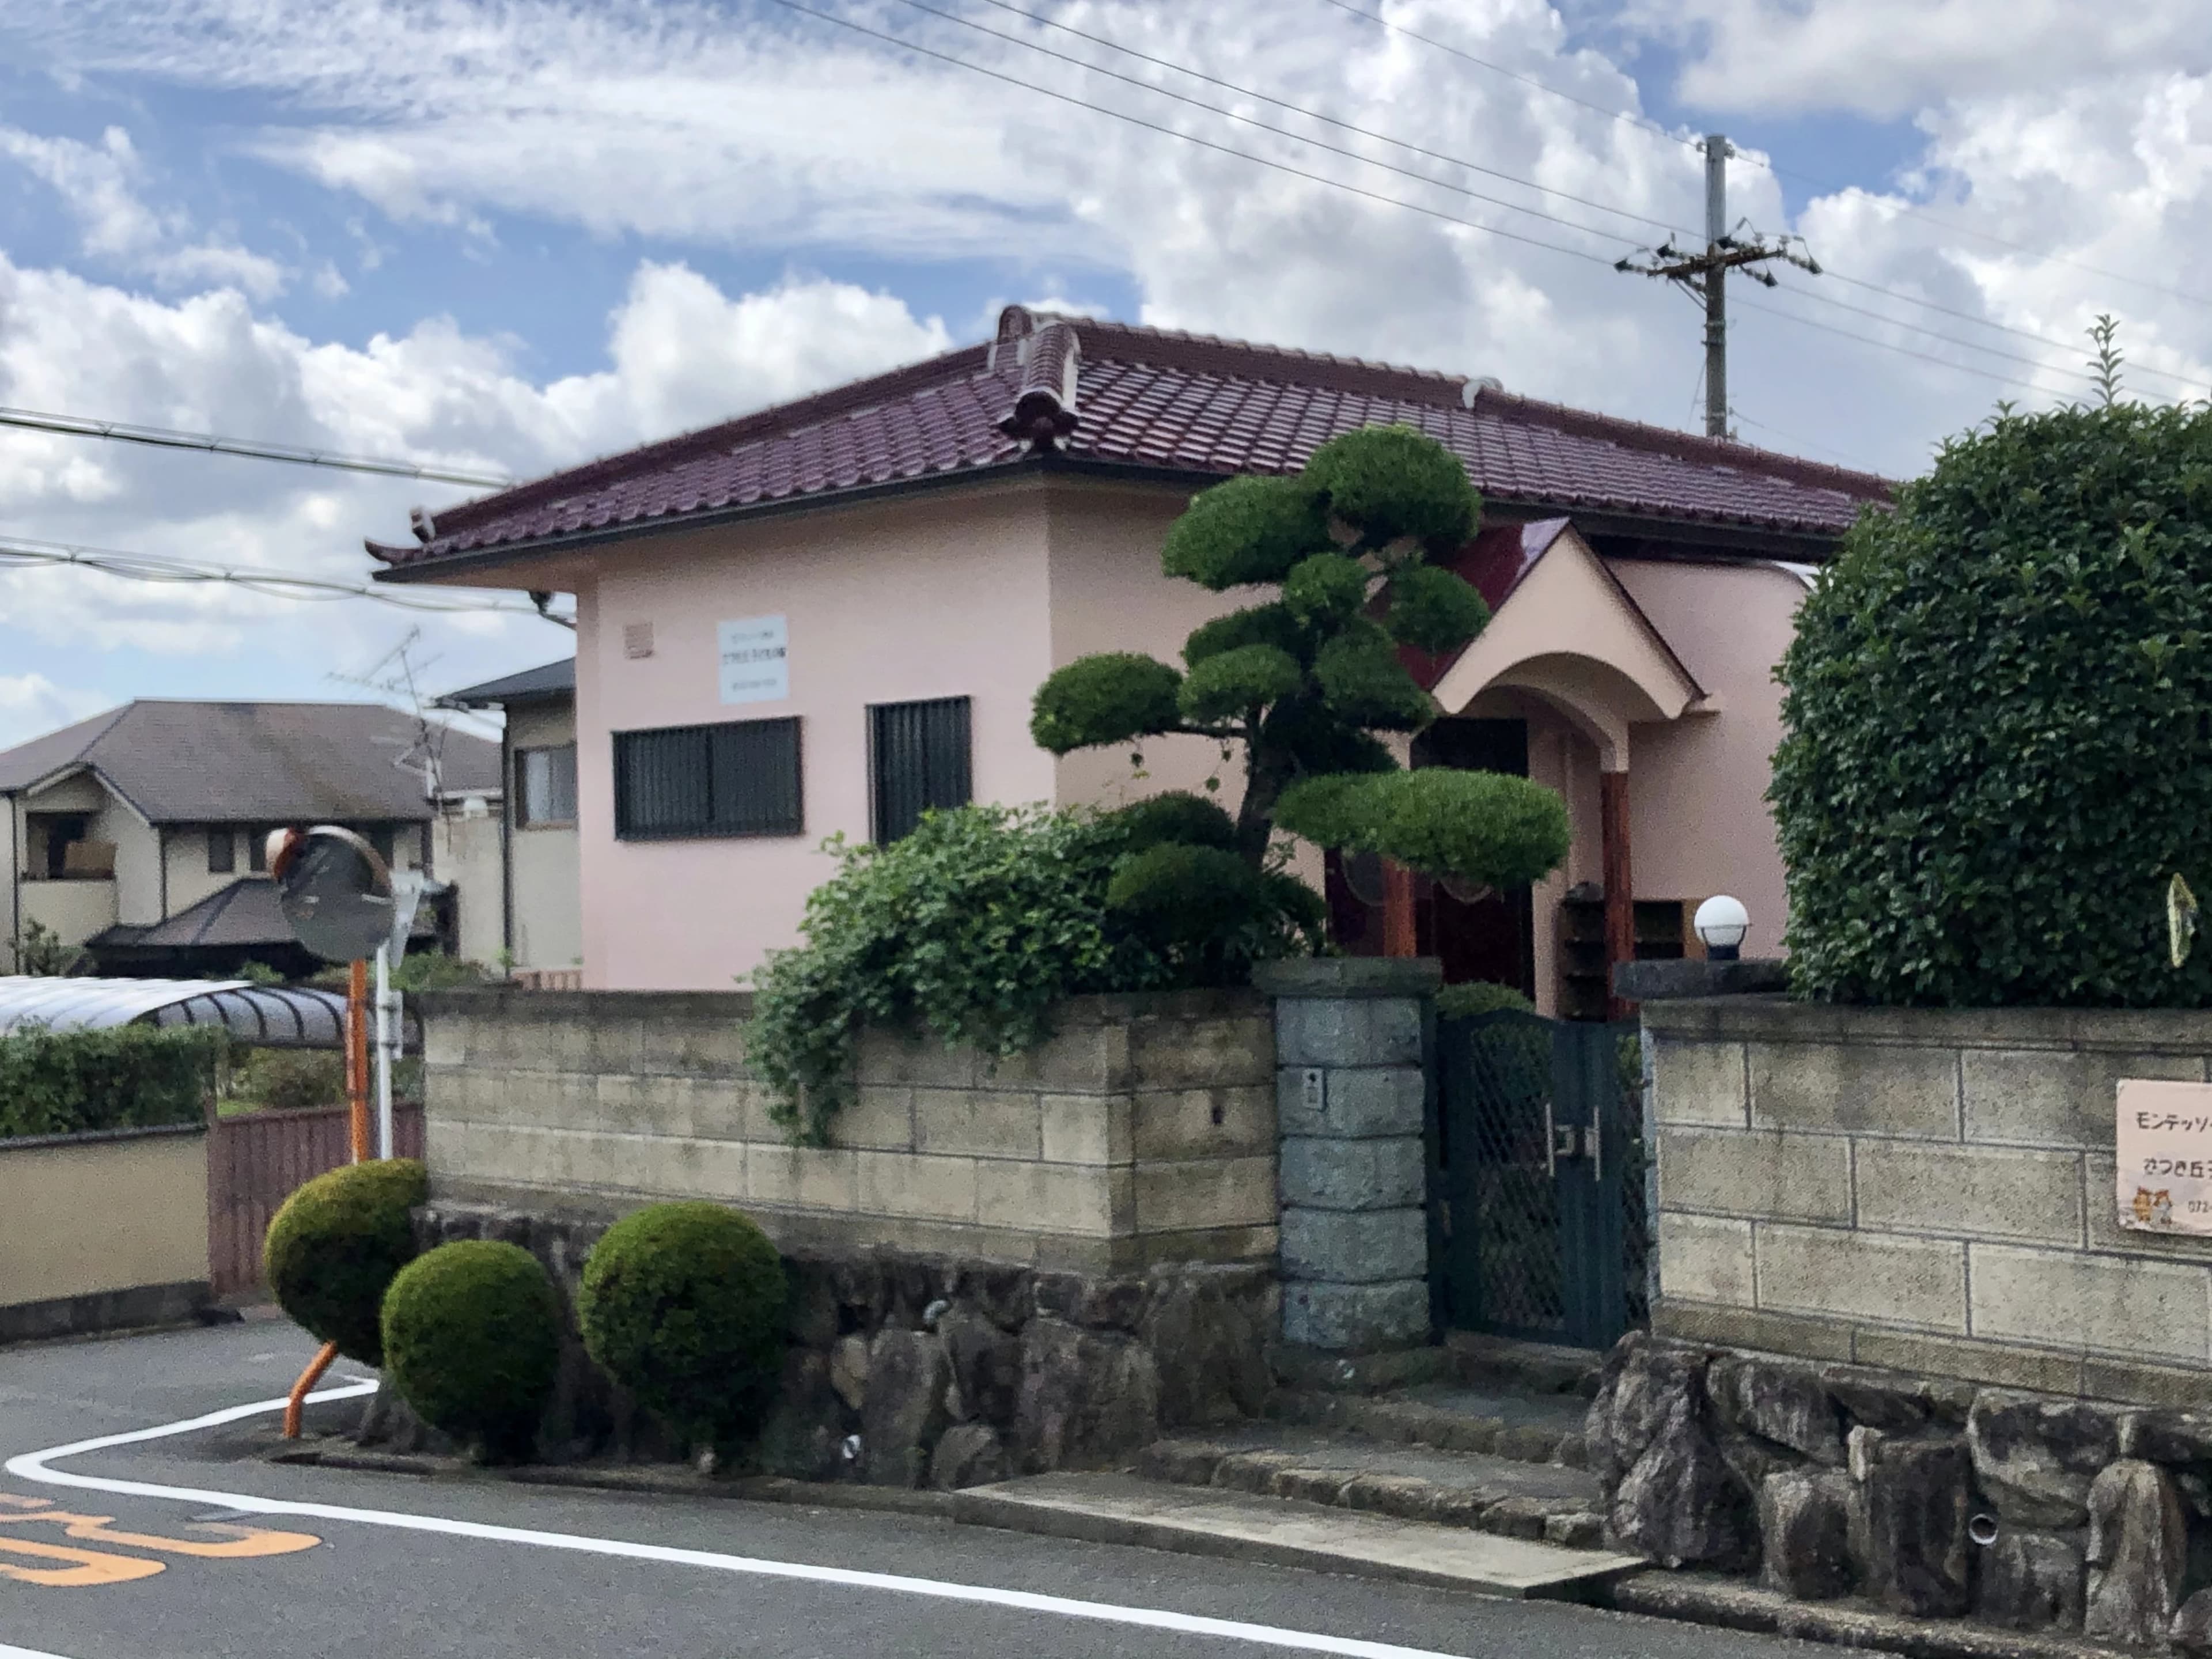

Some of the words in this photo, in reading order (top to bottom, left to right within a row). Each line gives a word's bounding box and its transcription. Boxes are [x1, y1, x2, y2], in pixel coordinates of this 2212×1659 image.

[2137, 1112, 2212, 1132] モンテッソ
